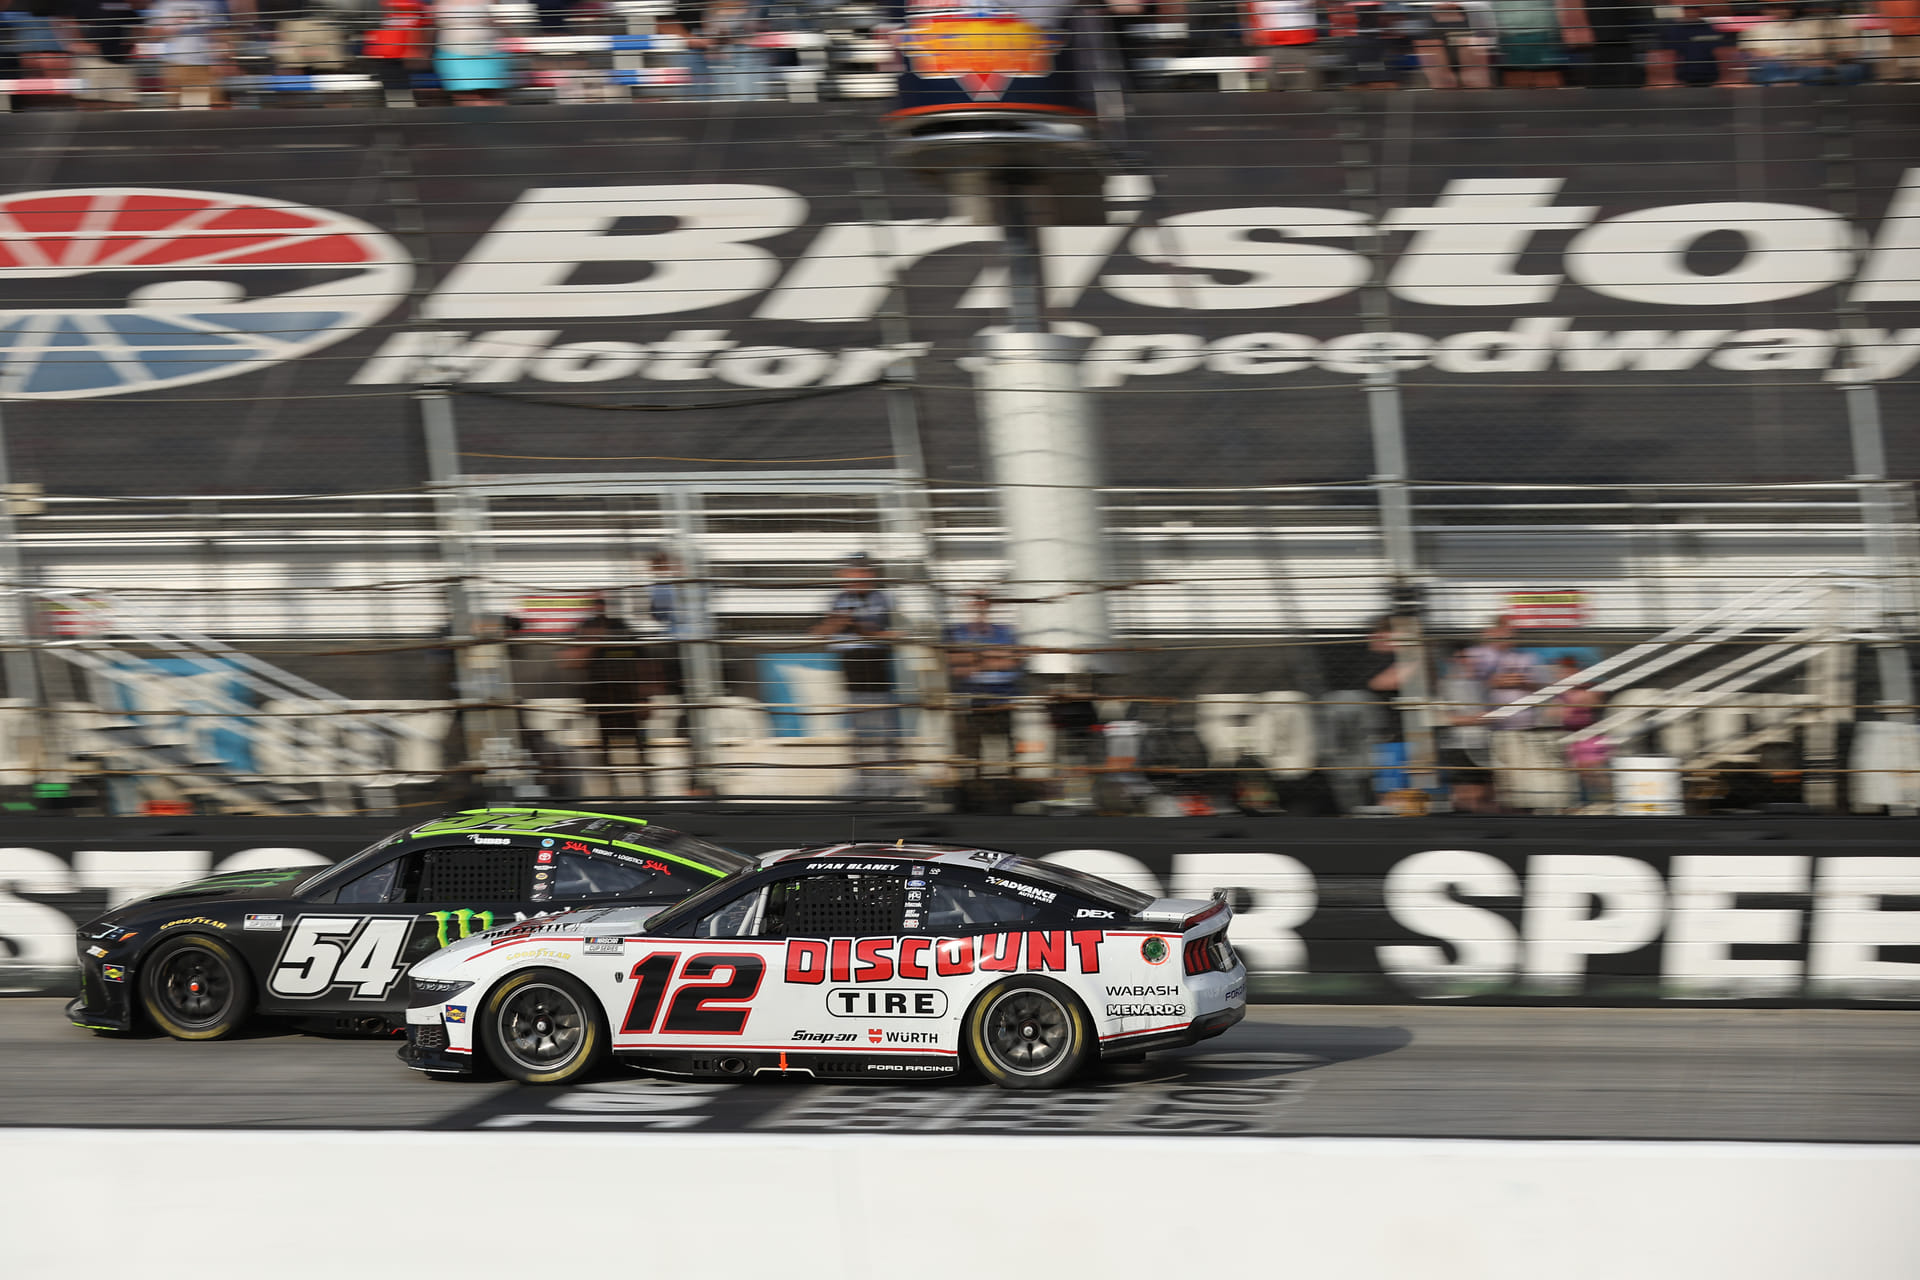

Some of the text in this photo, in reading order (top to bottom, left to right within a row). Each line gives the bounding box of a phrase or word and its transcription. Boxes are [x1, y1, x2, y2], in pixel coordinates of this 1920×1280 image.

[346, 316, 1920, 388] Motor peedway
[561, 841, 591, 855] SAIA
[618, 854, 644, 865] LOGISTICS
[642, 860, 671, 875] SAIA
[846, 863, 900, 871] BLANEY
[999, 879, 1057, 900] ADVANCE
[1018, 891, 1053, 904] AUTO PARTS
[1076, 908, 1116, 919] DEX
[160, 916, 228, 930] GOODYEAR
[268, 914, 416, 999] 54
[506, 947, 572, 961] GOODYEAR
[784, 930, 1104, 985] DISCOUNT
[619, 952, 767, 1035] 12
[1105, 985, 1179, 996] WABASH
[838, 993, 934, 1014] TIRE
[1106, 1003, 1186, 1016] MENARDS
[791, 1030, 858, 1043] Snap-on
